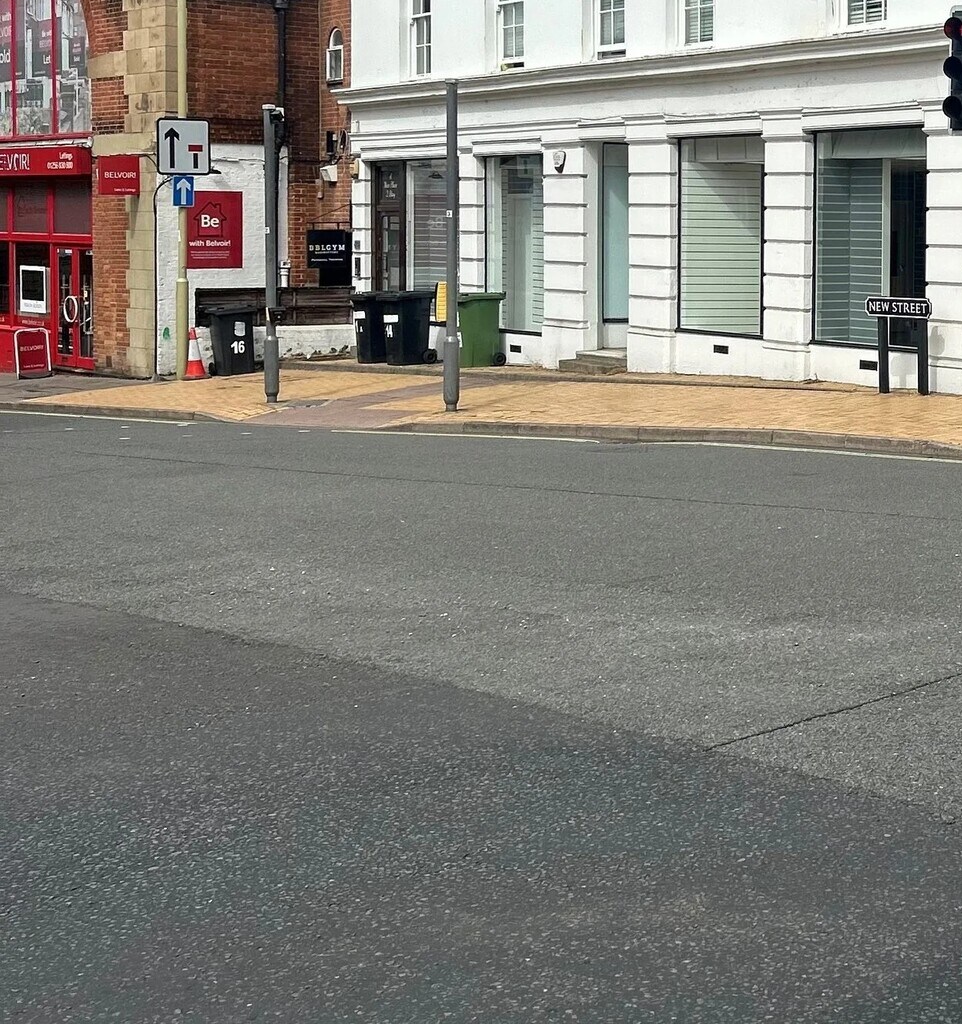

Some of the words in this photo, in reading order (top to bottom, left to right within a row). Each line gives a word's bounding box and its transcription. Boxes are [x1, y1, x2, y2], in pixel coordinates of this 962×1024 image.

[104, 171, 137, 179] BELVOIR!
[201, 214, 220, 228] Be
[189, 239, 205, 247] with
[205, 239, 231, 247] Belvoir!
[868, 301, 890, 312] NEW
[892, 302, 928, 314] STREET
[230, 340, 245, 354] 16
